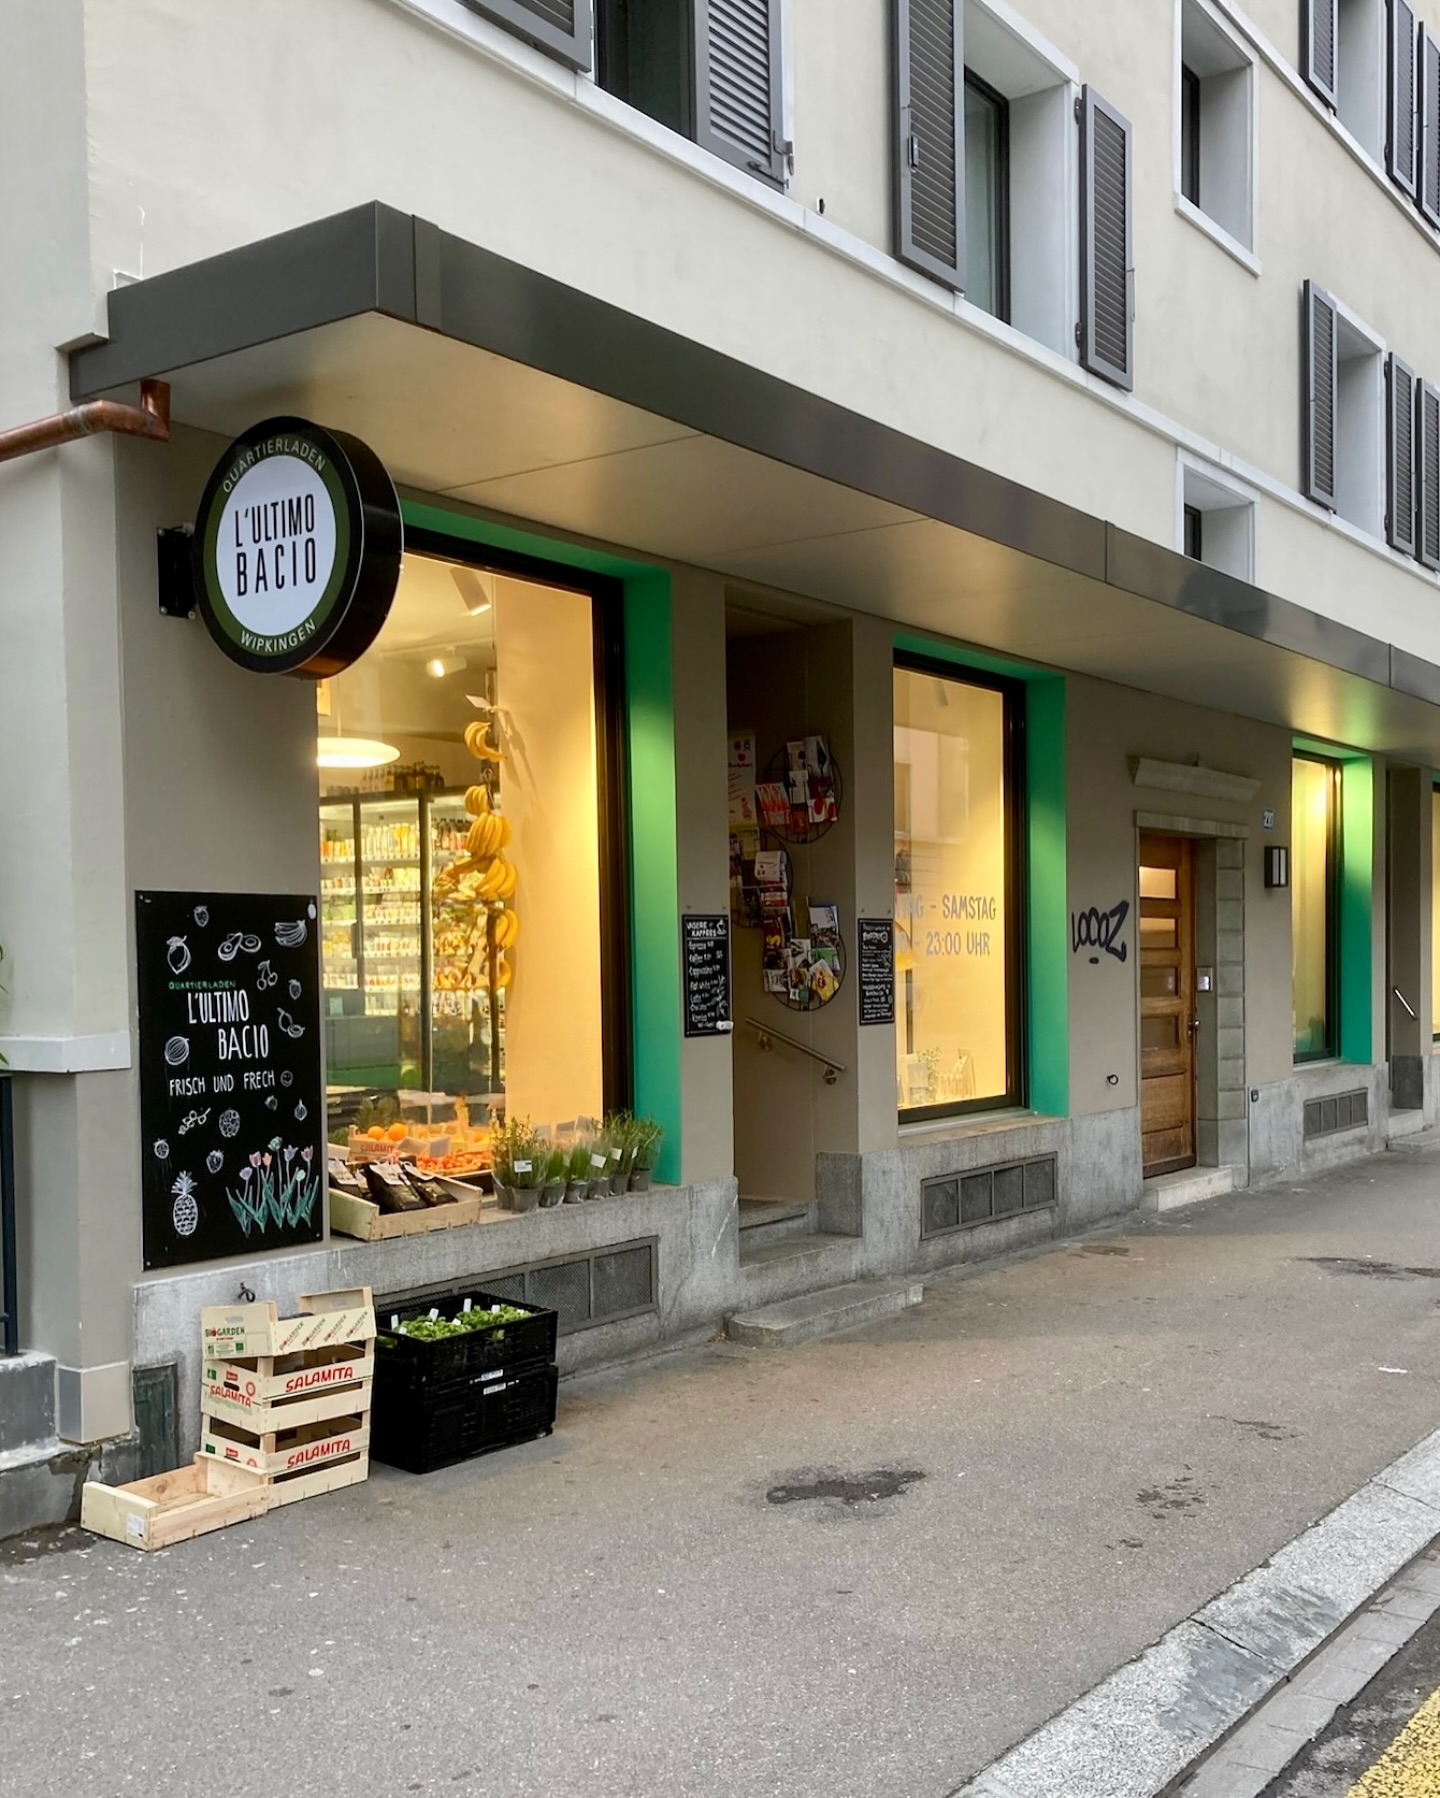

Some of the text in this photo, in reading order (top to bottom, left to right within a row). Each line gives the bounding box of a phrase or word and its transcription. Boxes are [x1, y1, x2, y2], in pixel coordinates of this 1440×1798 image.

[222, 438, 326, 494] QUARTIERLADEN
[235, 494, 315, 548] L'ULTIMO
[236, 537, 316, 597] BACIO
[240, 618, 316, 652] WIPKINGEN
[942, 893, 997, 921] SAMSTAG
[926, 930, 963, 958] 23:00
[966, 930, 992, 958] UHR
[168, 980, 236, 990] QUARTIERLADEN
[187, 989, 250, 1024] L'ULTIMO
[218, 1024, 269, 1060] BACIO
[169, 1069, 276, 1096] FRISCH UND FRECH
[286, 1366, 354, 1392] SALAMITA
[210, 1385, 251, 1408] SALAMITA
[286, 1439, 351, 1469] SALAMITA
